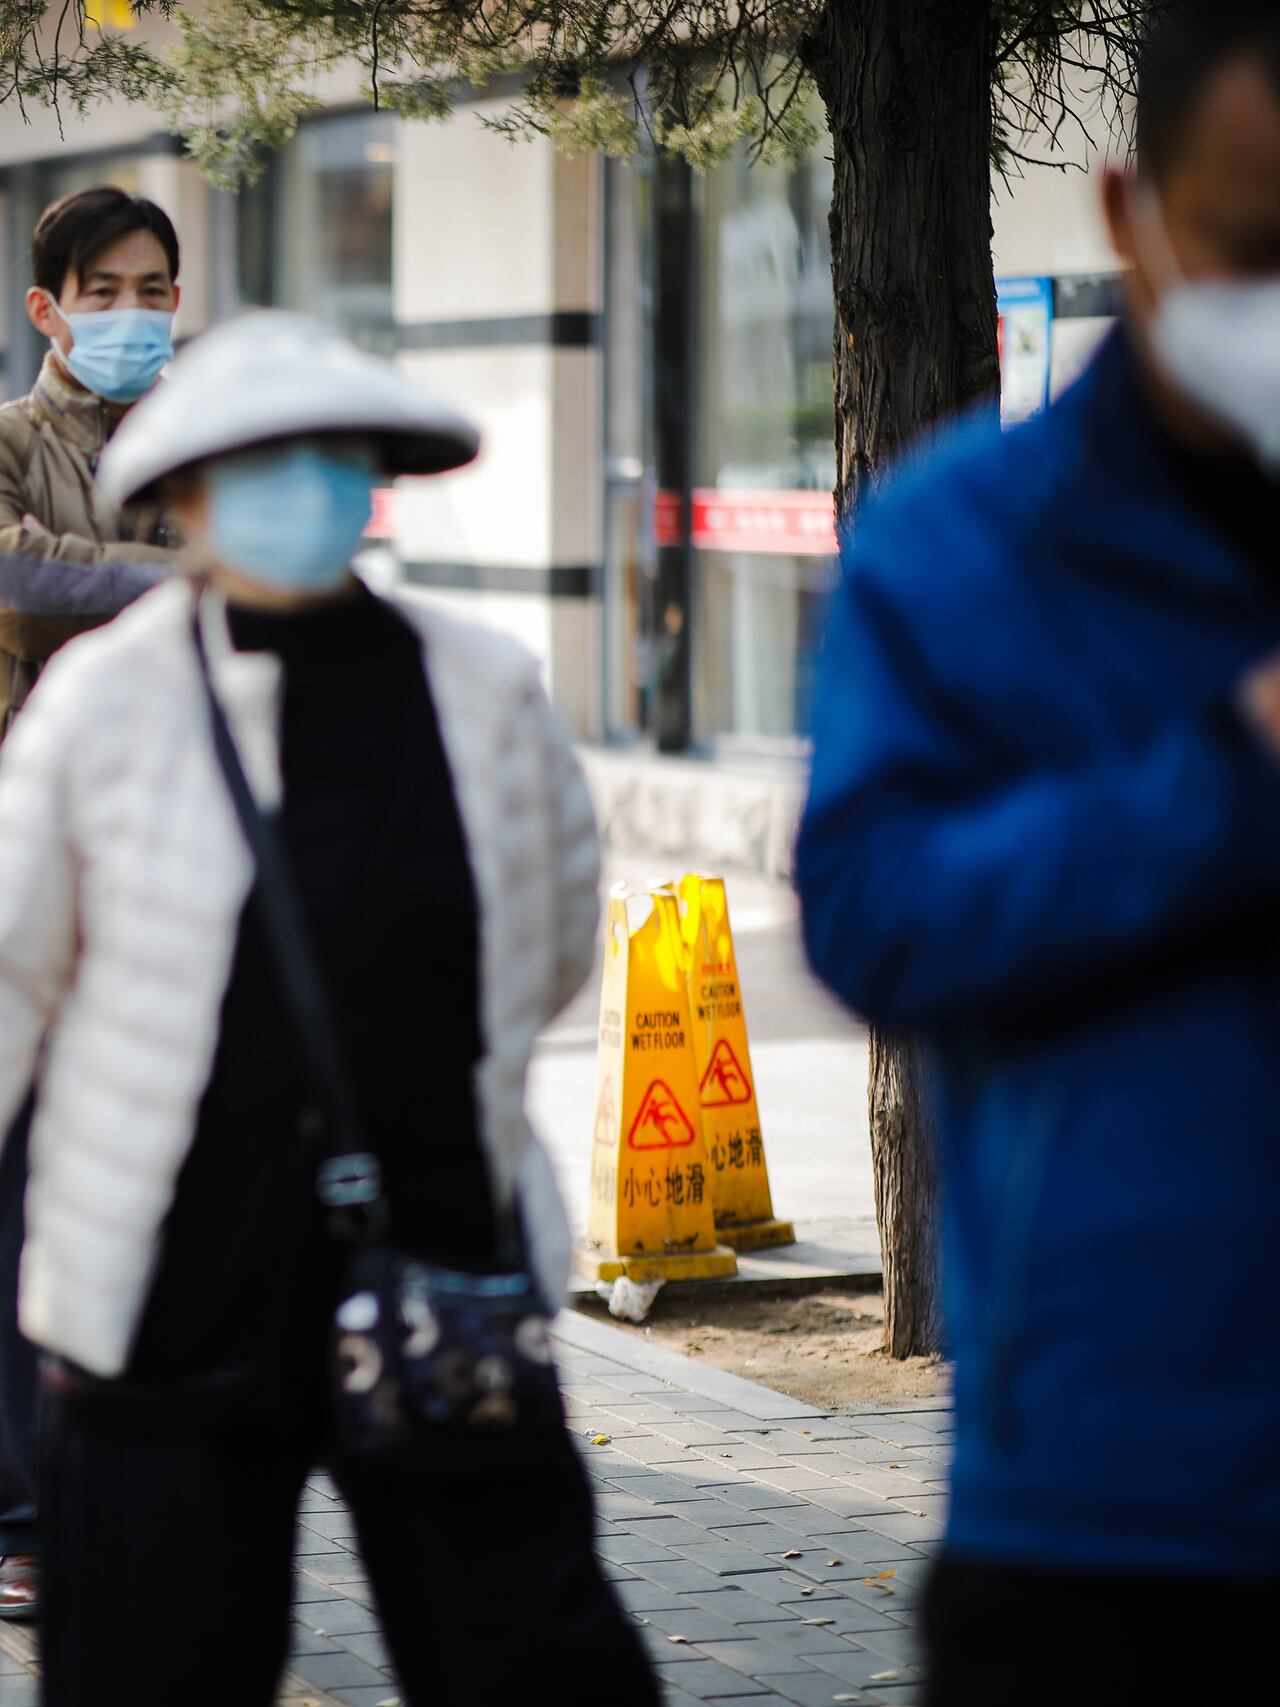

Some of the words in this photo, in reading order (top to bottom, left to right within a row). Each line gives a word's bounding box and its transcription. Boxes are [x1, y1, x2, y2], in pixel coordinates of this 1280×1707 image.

[700, 984, 736, 1000] CAUTION
[635, 1011, 680, 1029] CAUTION
[631, 1033, 652, 1050] WET
[654, 1031, 685, 1049] FLOOR
[706, 1128, 762, 1171] 心地滑
[624, 1163, 705, 1208] 小心地滑
